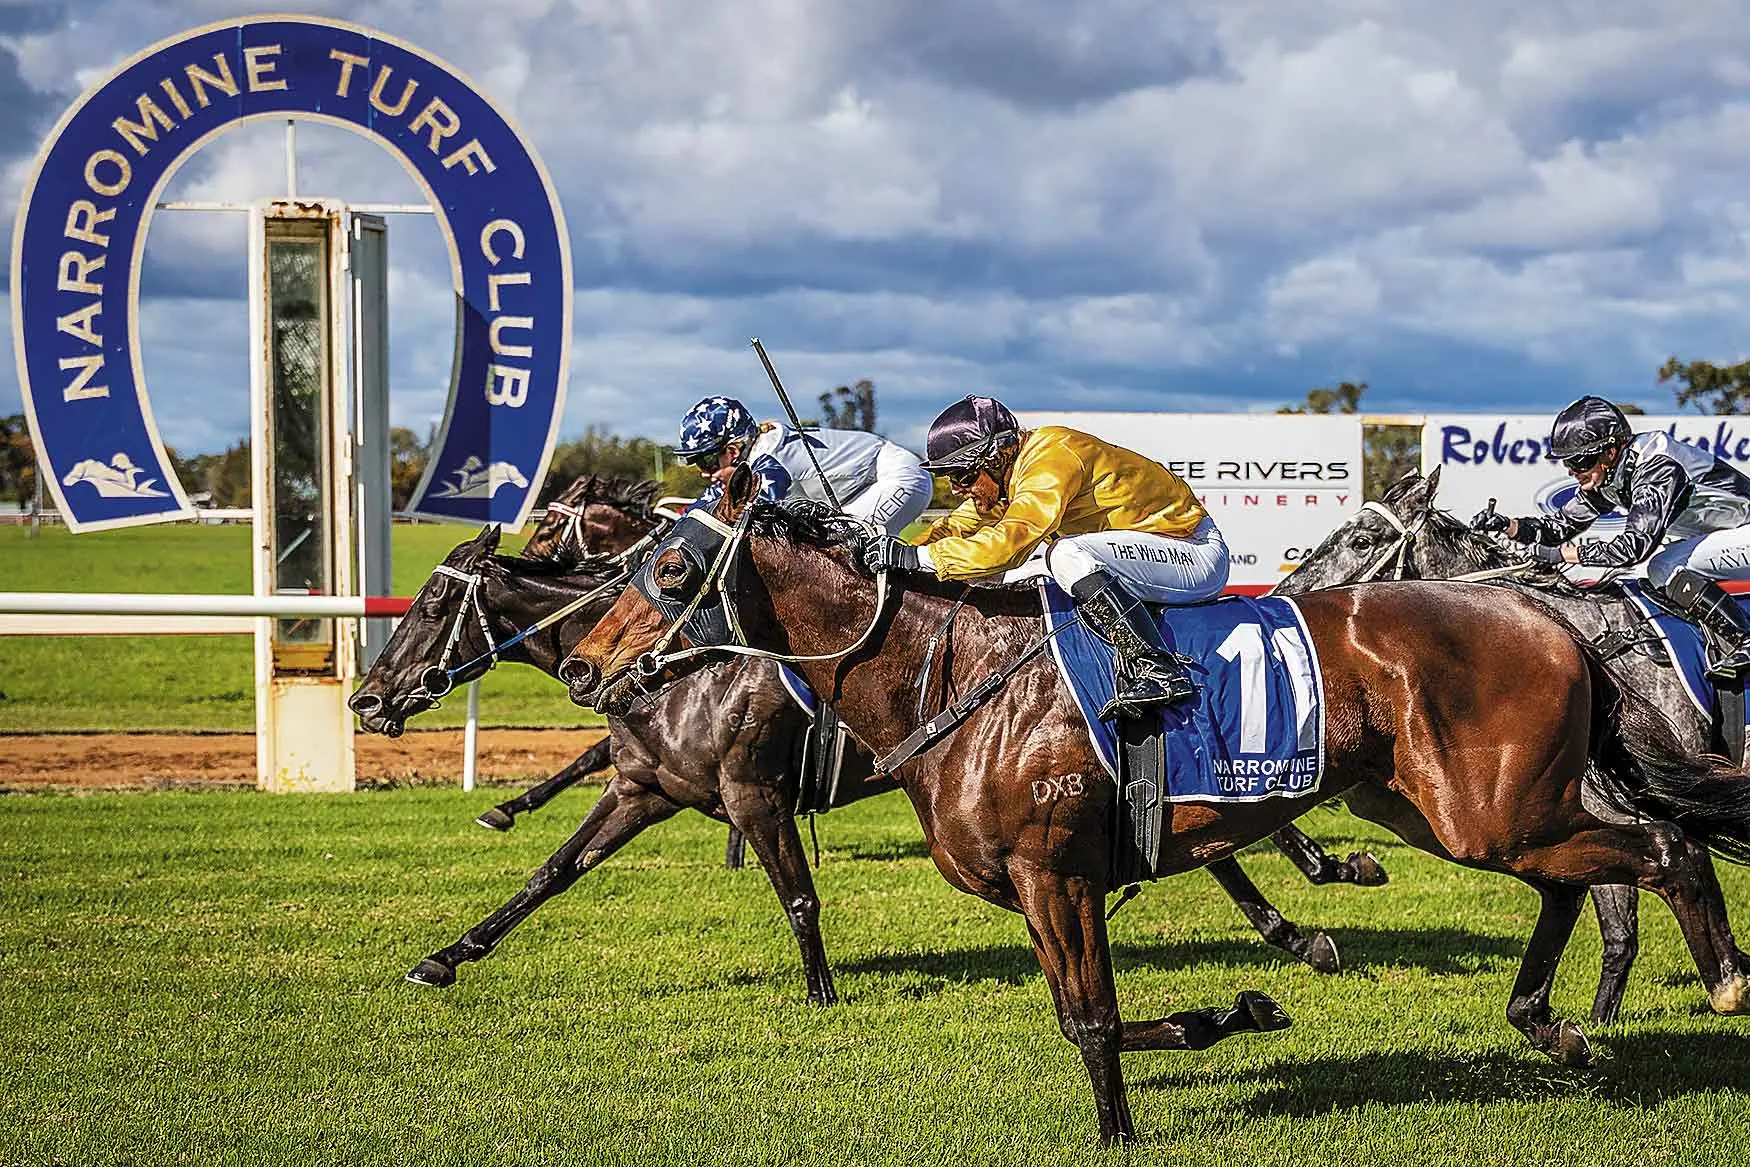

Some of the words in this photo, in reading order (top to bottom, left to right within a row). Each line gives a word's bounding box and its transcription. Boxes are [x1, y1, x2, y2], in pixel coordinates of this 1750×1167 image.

[57, 44, 288, 403] NARROMINE
[328, 48, 497, 178] TURF
[479, 218, 534, 409] CLUB
[1168, 461, 1205, 479] EE
[1217, 461, 1349, 480] RIVERS
[1106, 542, 1136, 560] THE
[1134, 543, 1167, 563] WILD
[1167, 547, 1196, 566] MAN
[1230, 554, 1257, 565] AND
[1216, 622, 1317, 753] 11
[1213, 756, 1316, 775] NARROMINE
[1216, 776, 1259, 792] TURF
[1265, 773, 1313, 790] CLUB
